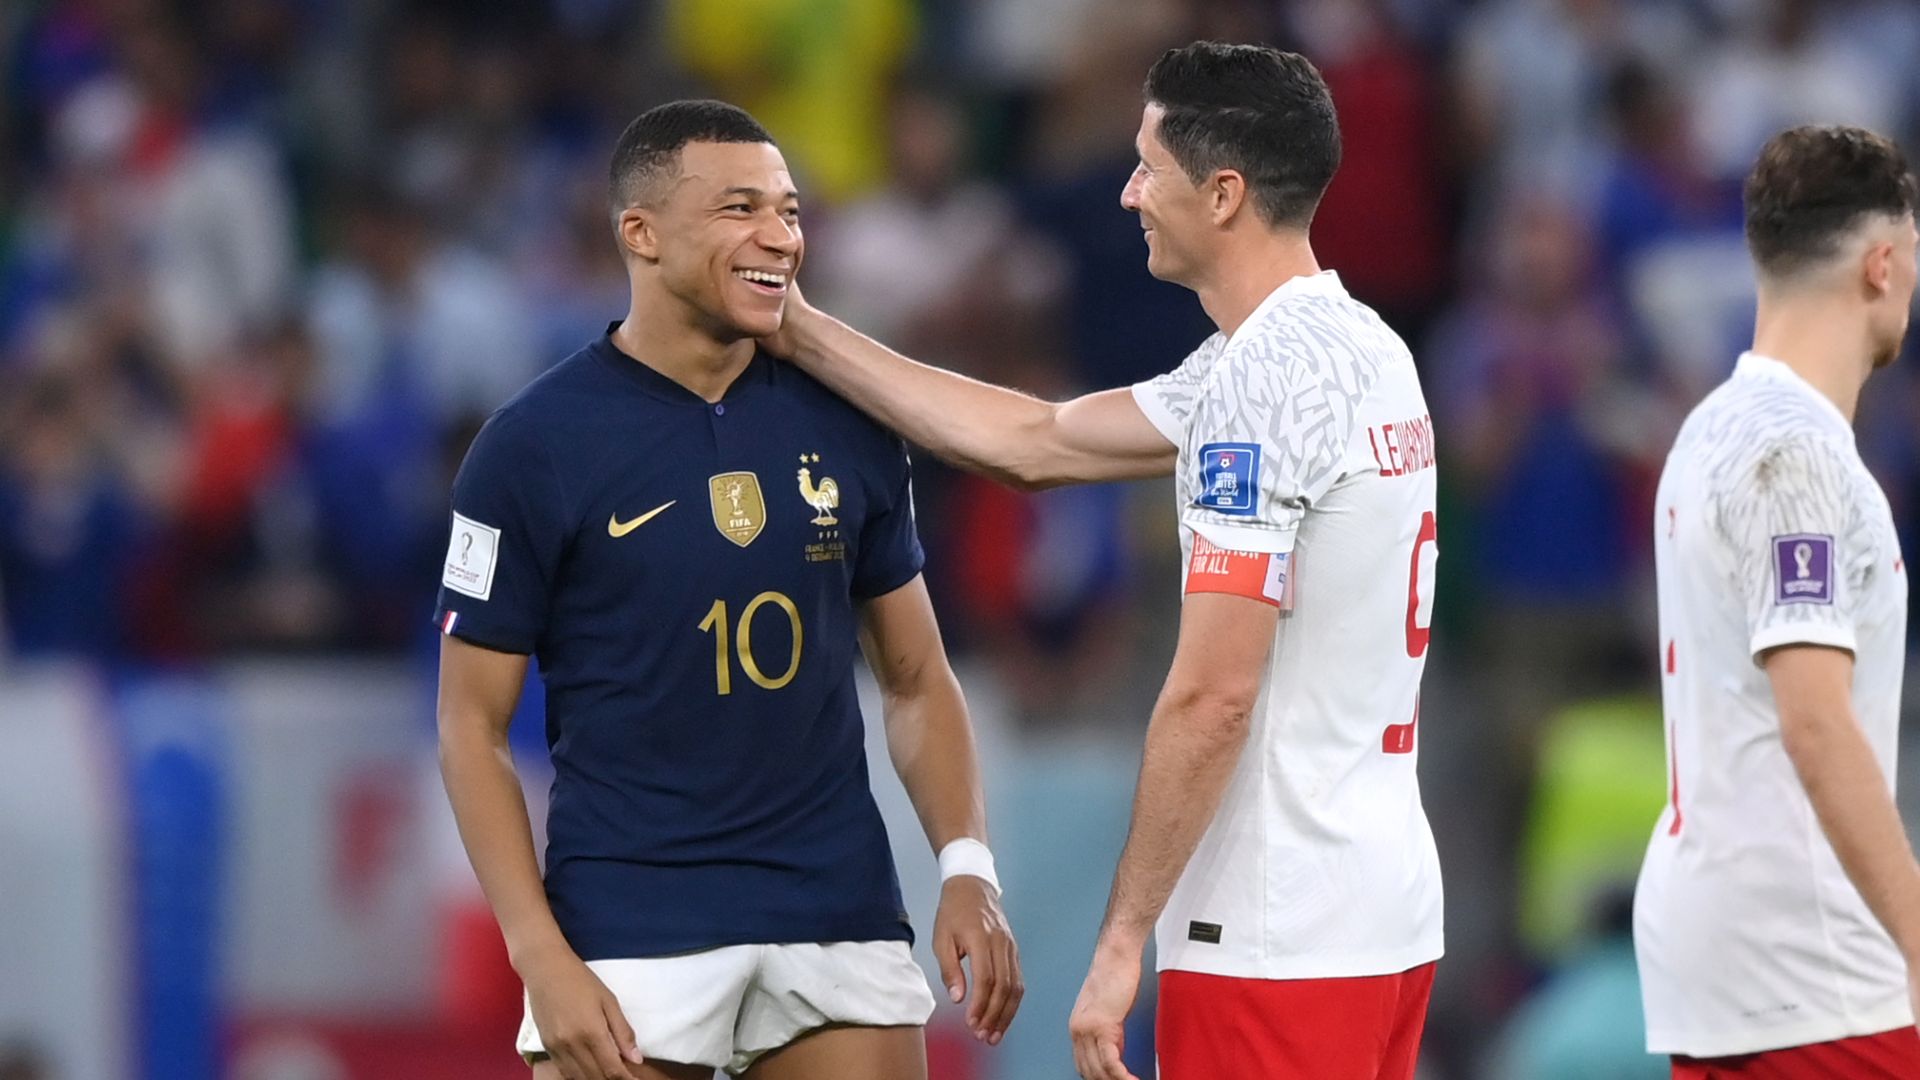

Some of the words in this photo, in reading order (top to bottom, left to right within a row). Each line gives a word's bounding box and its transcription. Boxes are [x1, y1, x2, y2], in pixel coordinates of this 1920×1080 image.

[729, 518, 752, 528] FIFA
[1191, 556, 1207, 575] FOR
[1207, 556, 1229, 575] ALL
[697, 591, 803, 695] 10
